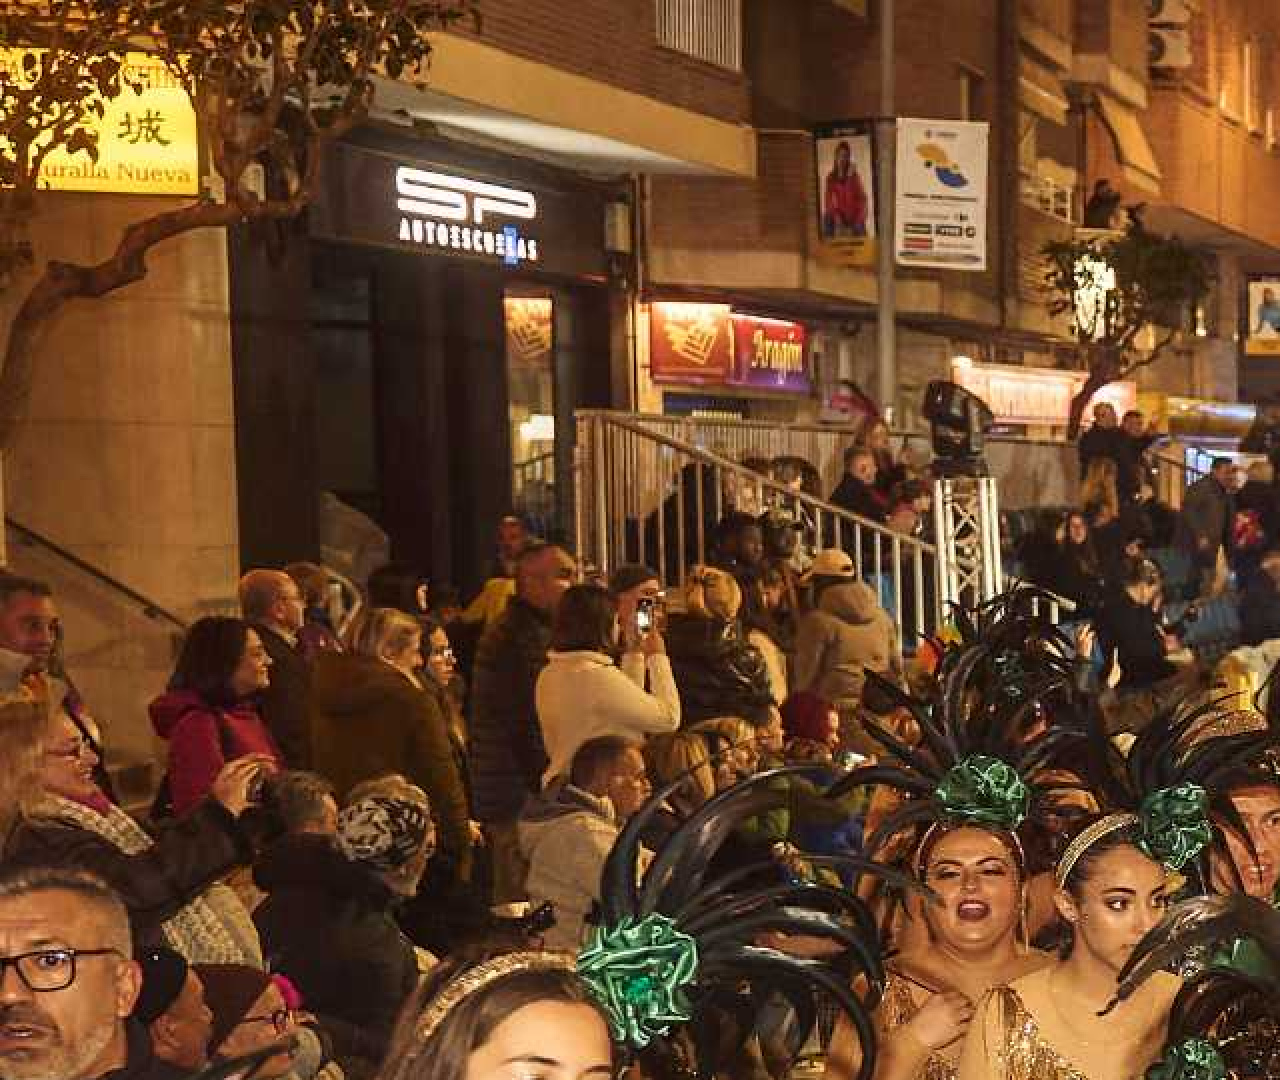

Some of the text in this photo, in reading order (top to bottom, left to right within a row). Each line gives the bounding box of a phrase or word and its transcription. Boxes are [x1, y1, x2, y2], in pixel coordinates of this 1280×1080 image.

[42, 162, 192, 182] uralla Nueva
[395, 166, 537, 224] SP
[399, 216, 538, 265] AUTOESCUELAS
